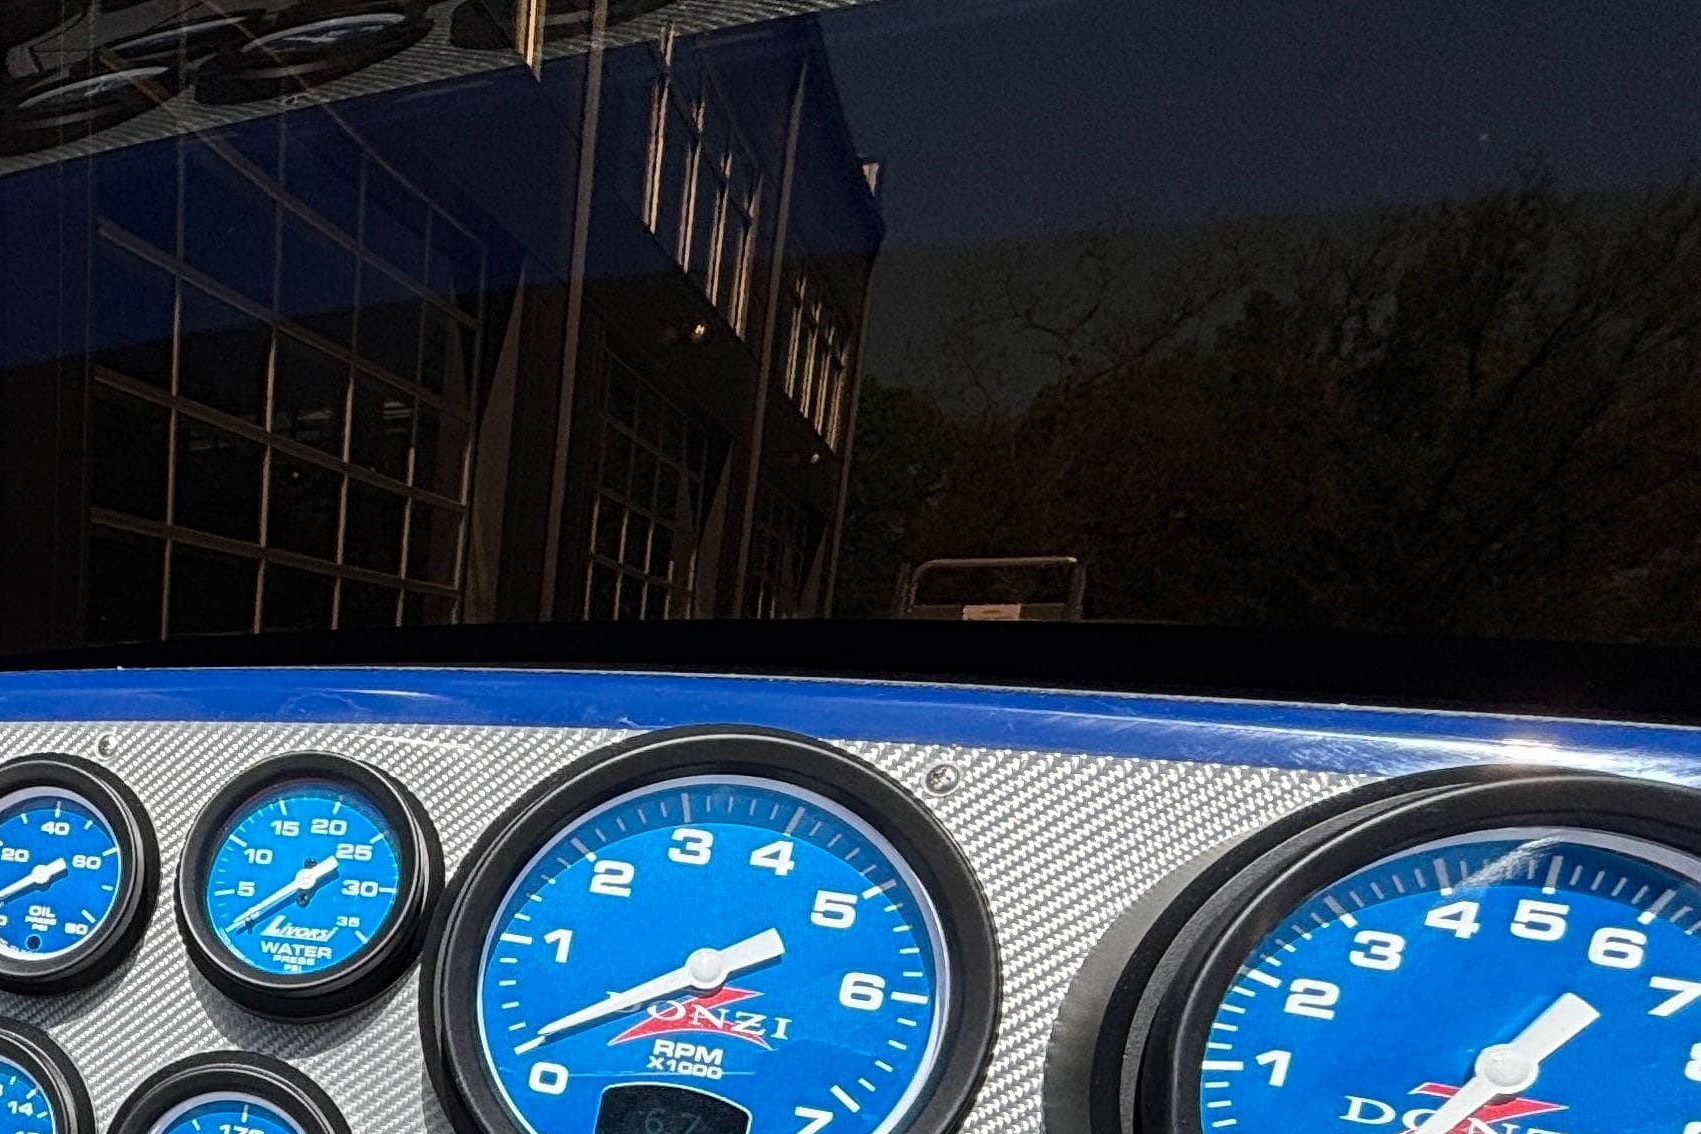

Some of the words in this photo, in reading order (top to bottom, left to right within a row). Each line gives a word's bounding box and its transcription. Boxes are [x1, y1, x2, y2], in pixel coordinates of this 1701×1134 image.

[41, 821, 70, 836] 40
[270, 820, 300, 837] 15
[310, 818, 347, 836] 20
[1, 847, 29, 862] 20
[243, 848, 273, 865] 10
[335, 843, 373, 861] 25
[668, 827, 714, 866] 3
[749, 839, 796, 878] 4
[72, 855, 101, 870] 60
[237, 881, 255, 897] 5
[341, 879, 378, 897] 30
[589, 859, 636, 899] 2
[29, 905, 55, 918] OIL
[810, 889, 859, 930] 5
[1424, 900, 1480, 940] 4
[1509, 899, 1570, 942] 5
[260, 940, 332, 959] WATER
[542, 928, 575, 964] 1
[1348, 930, 1406, 971] 3
[1587, 927, 1648, 970] 6
[839, 972, 886, 1012] 6
[1283, 978, 1341, 1021] 2
[1647, 976, 1701, 1017] 7
[653, 1038, 724, 1065] RPM
[528, 1061, 569, 1096] 0
[646, 1055, 724, 1080] X1000
[1255, 1049, 1293, 1088] 1
[7, 1101, 34, 1116] 14
